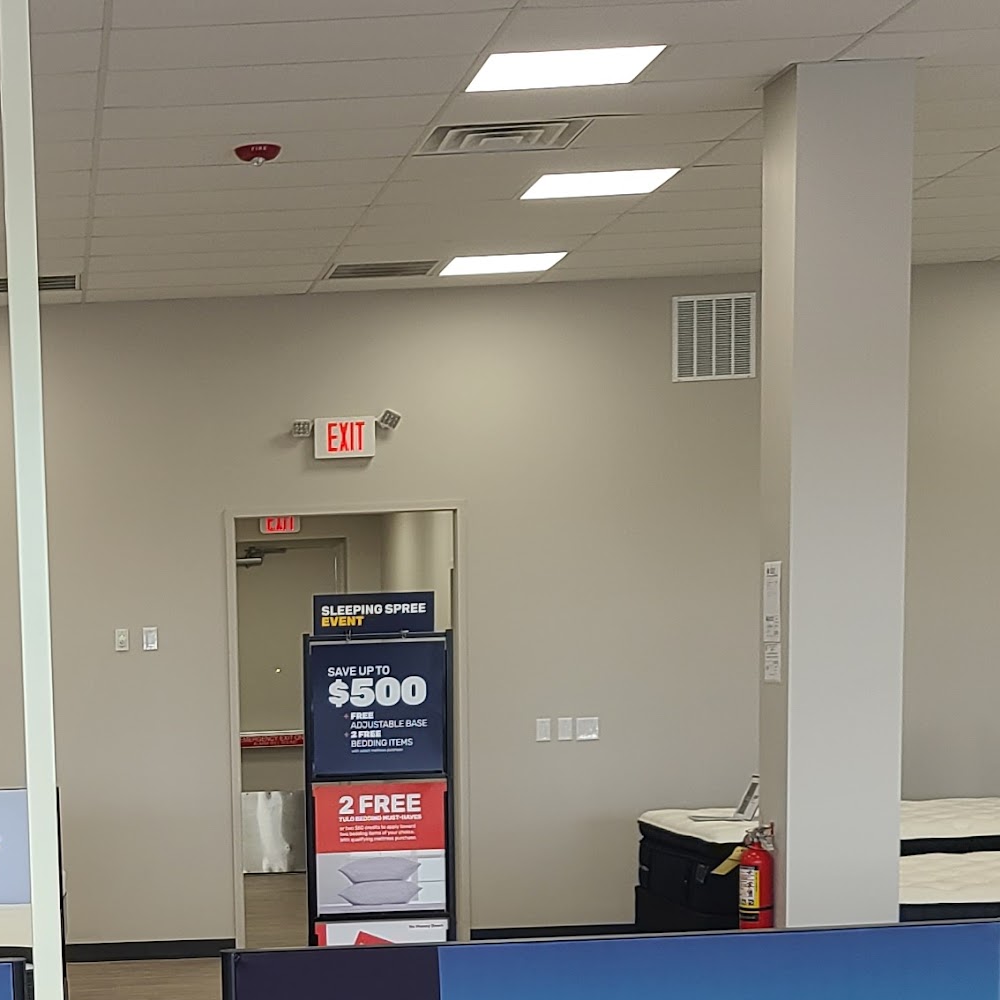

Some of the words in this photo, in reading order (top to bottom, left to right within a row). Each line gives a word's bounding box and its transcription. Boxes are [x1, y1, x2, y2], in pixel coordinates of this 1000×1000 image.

[326, 421, 365, 452] EXIT
[321, 604, 382, 616] SLEEPING
[384, 602, 426, 614] SPREE
[321, 616, 364, 627] EVENT
[328, 666, 356, 676] SAVE
[358, 666, 374, 676] UP
[375, 665, 390, 675] TO
[328, 676, 427, 708] $500
[350, 712, 374, 720] FREE
[350, 720, 404, 729] ADJUSTABLE
[406, 719, 428, 728] BASE
[358, 730, 381, 738] FREE
[350, 739, 388, 748] BEDDING
[388, 738, 414, 746] ITEMS
[339, 796, 354, 814] 2
[359, 793, 421, 814] FREE
